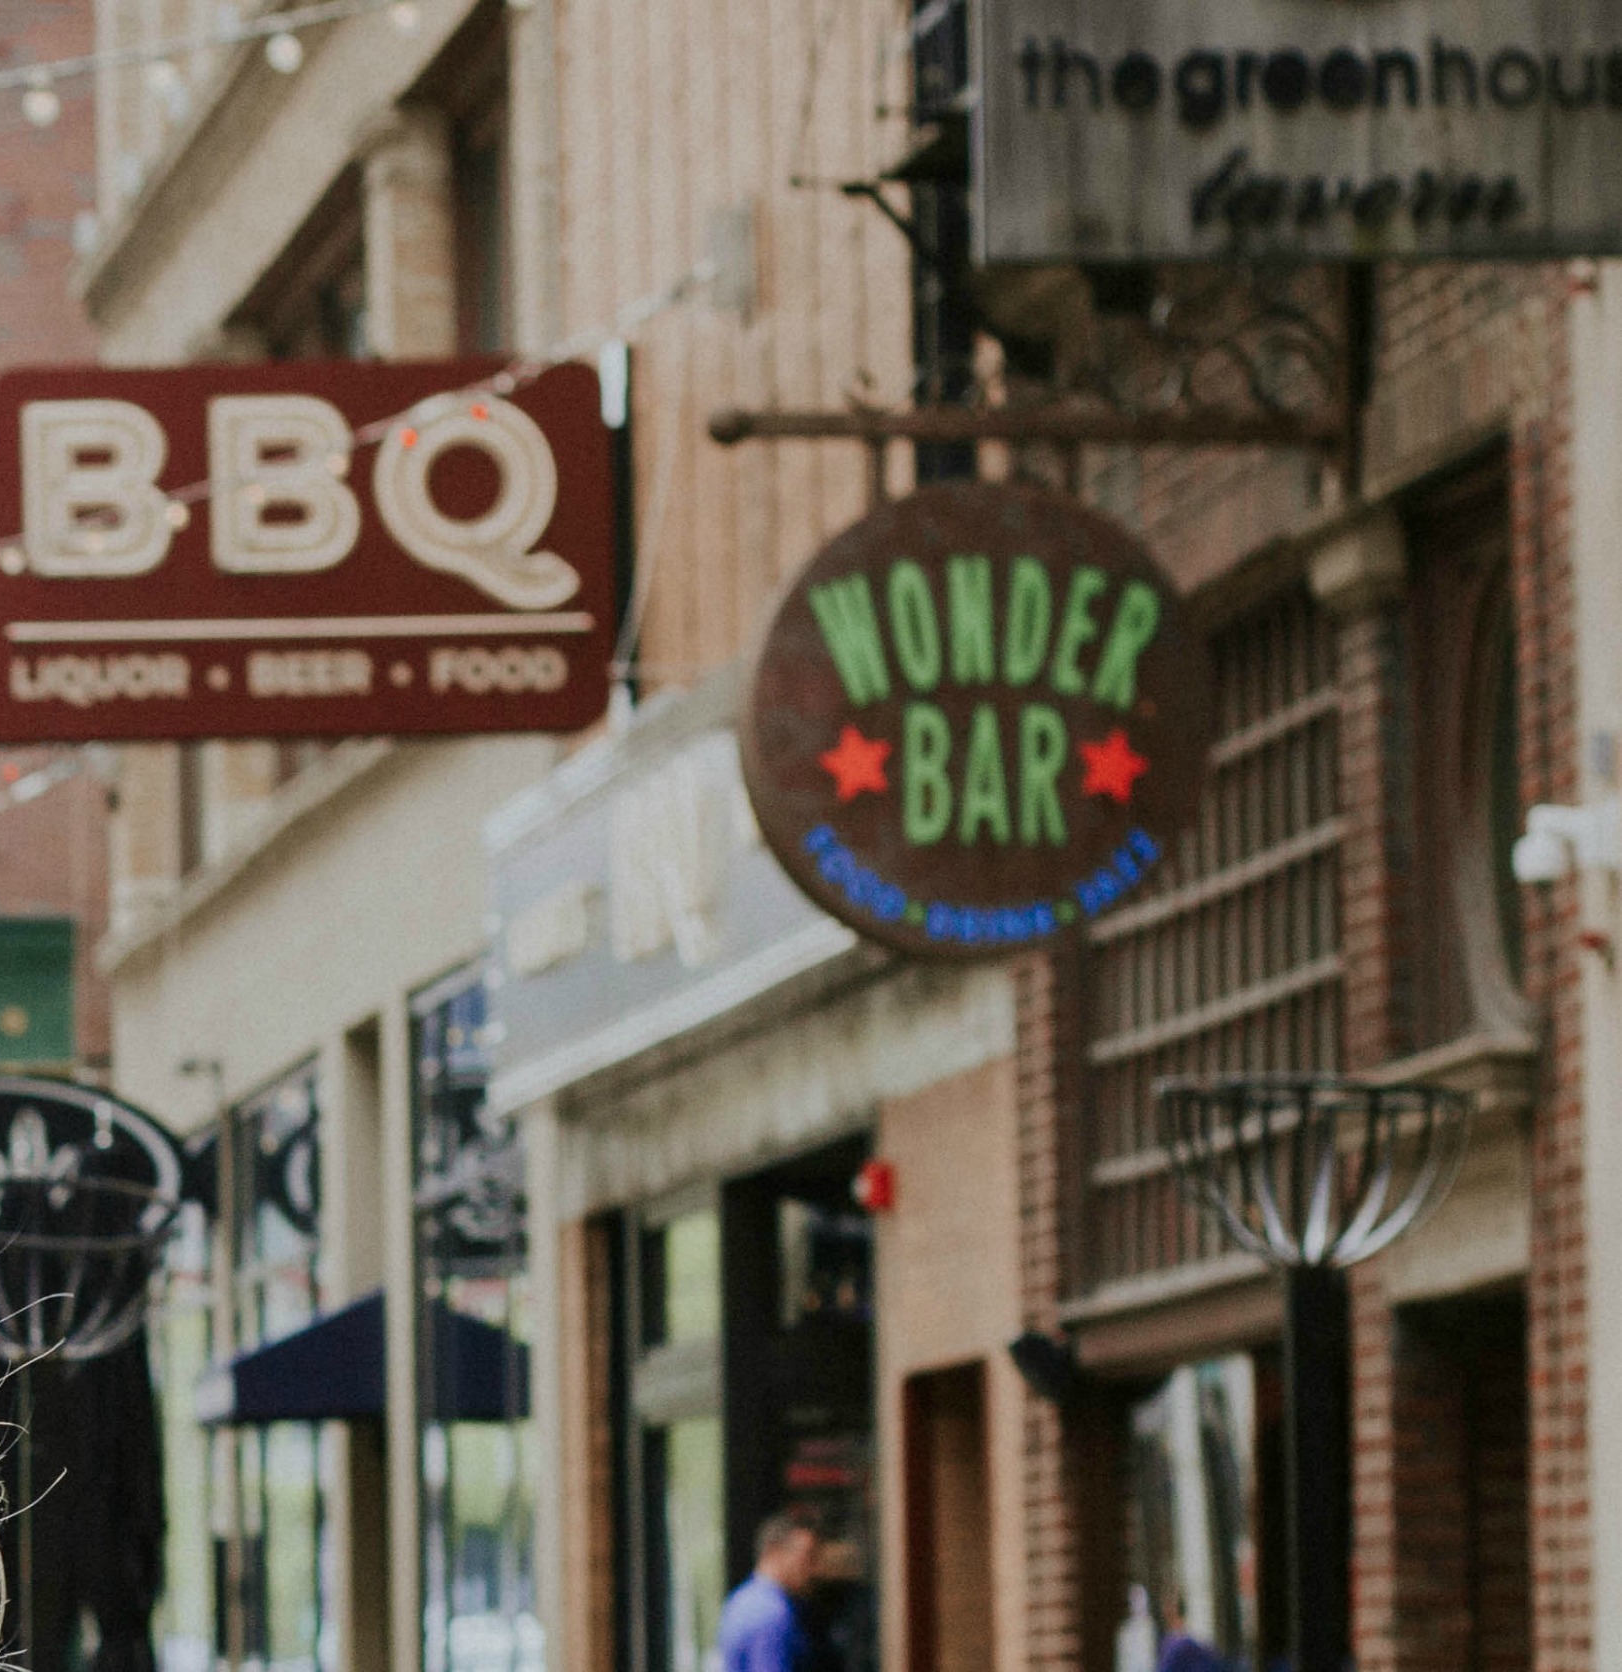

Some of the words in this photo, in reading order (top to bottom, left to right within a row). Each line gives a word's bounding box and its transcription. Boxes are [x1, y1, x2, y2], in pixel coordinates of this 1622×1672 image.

[18, 390, 583, 612] BBQ
[8, 653, 192, 707] LIQUOR
[245, 649, 374, 699] BEER
[427, 645, 569, 695] FOOD
[810, 555, 1160, 708] WONDER
[904, 702, 1068, 847] BAR
